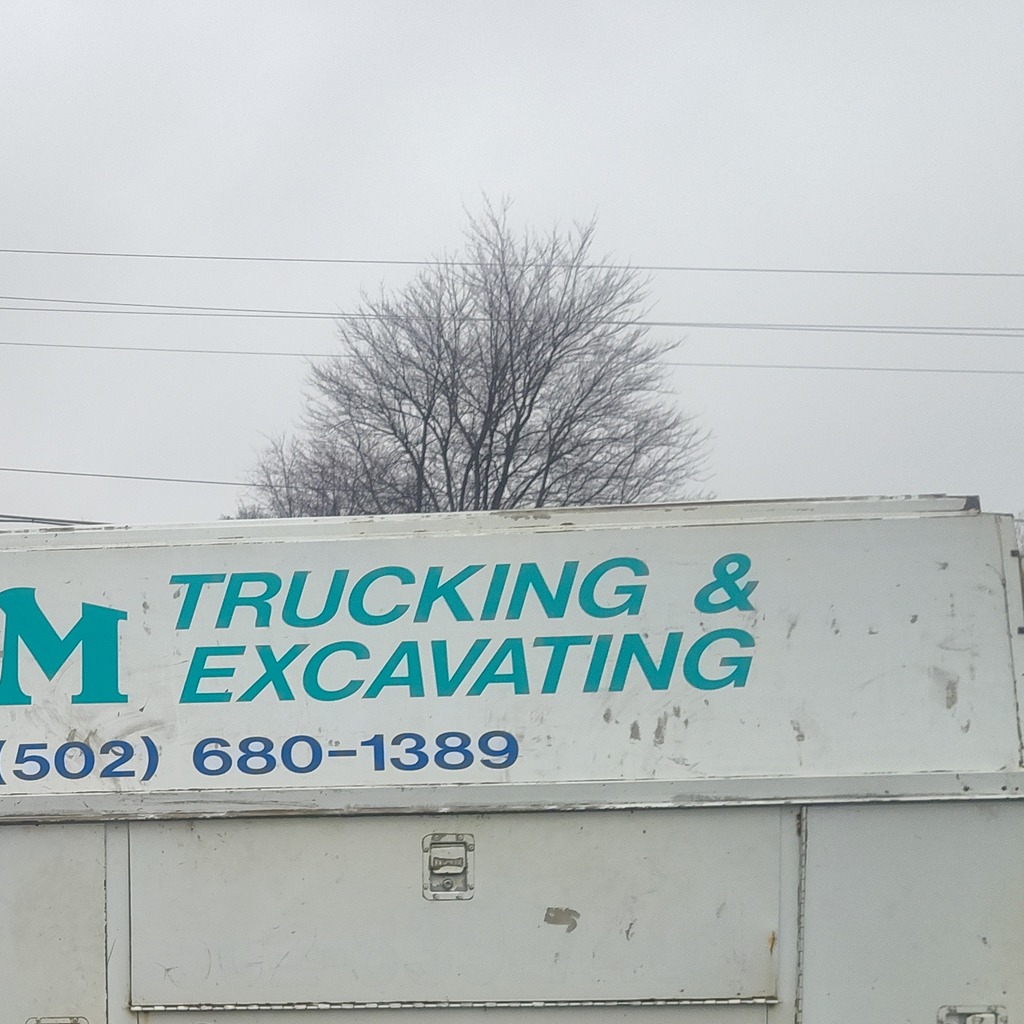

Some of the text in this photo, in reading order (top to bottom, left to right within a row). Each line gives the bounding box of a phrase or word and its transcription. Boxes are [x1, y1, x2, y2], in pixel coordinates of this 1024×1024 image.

[168, 552, 760, 630] TRUCKING &
[178, 627, 756, 704] EXCAVATING
[192, 730, 520, 776] 680-1389
